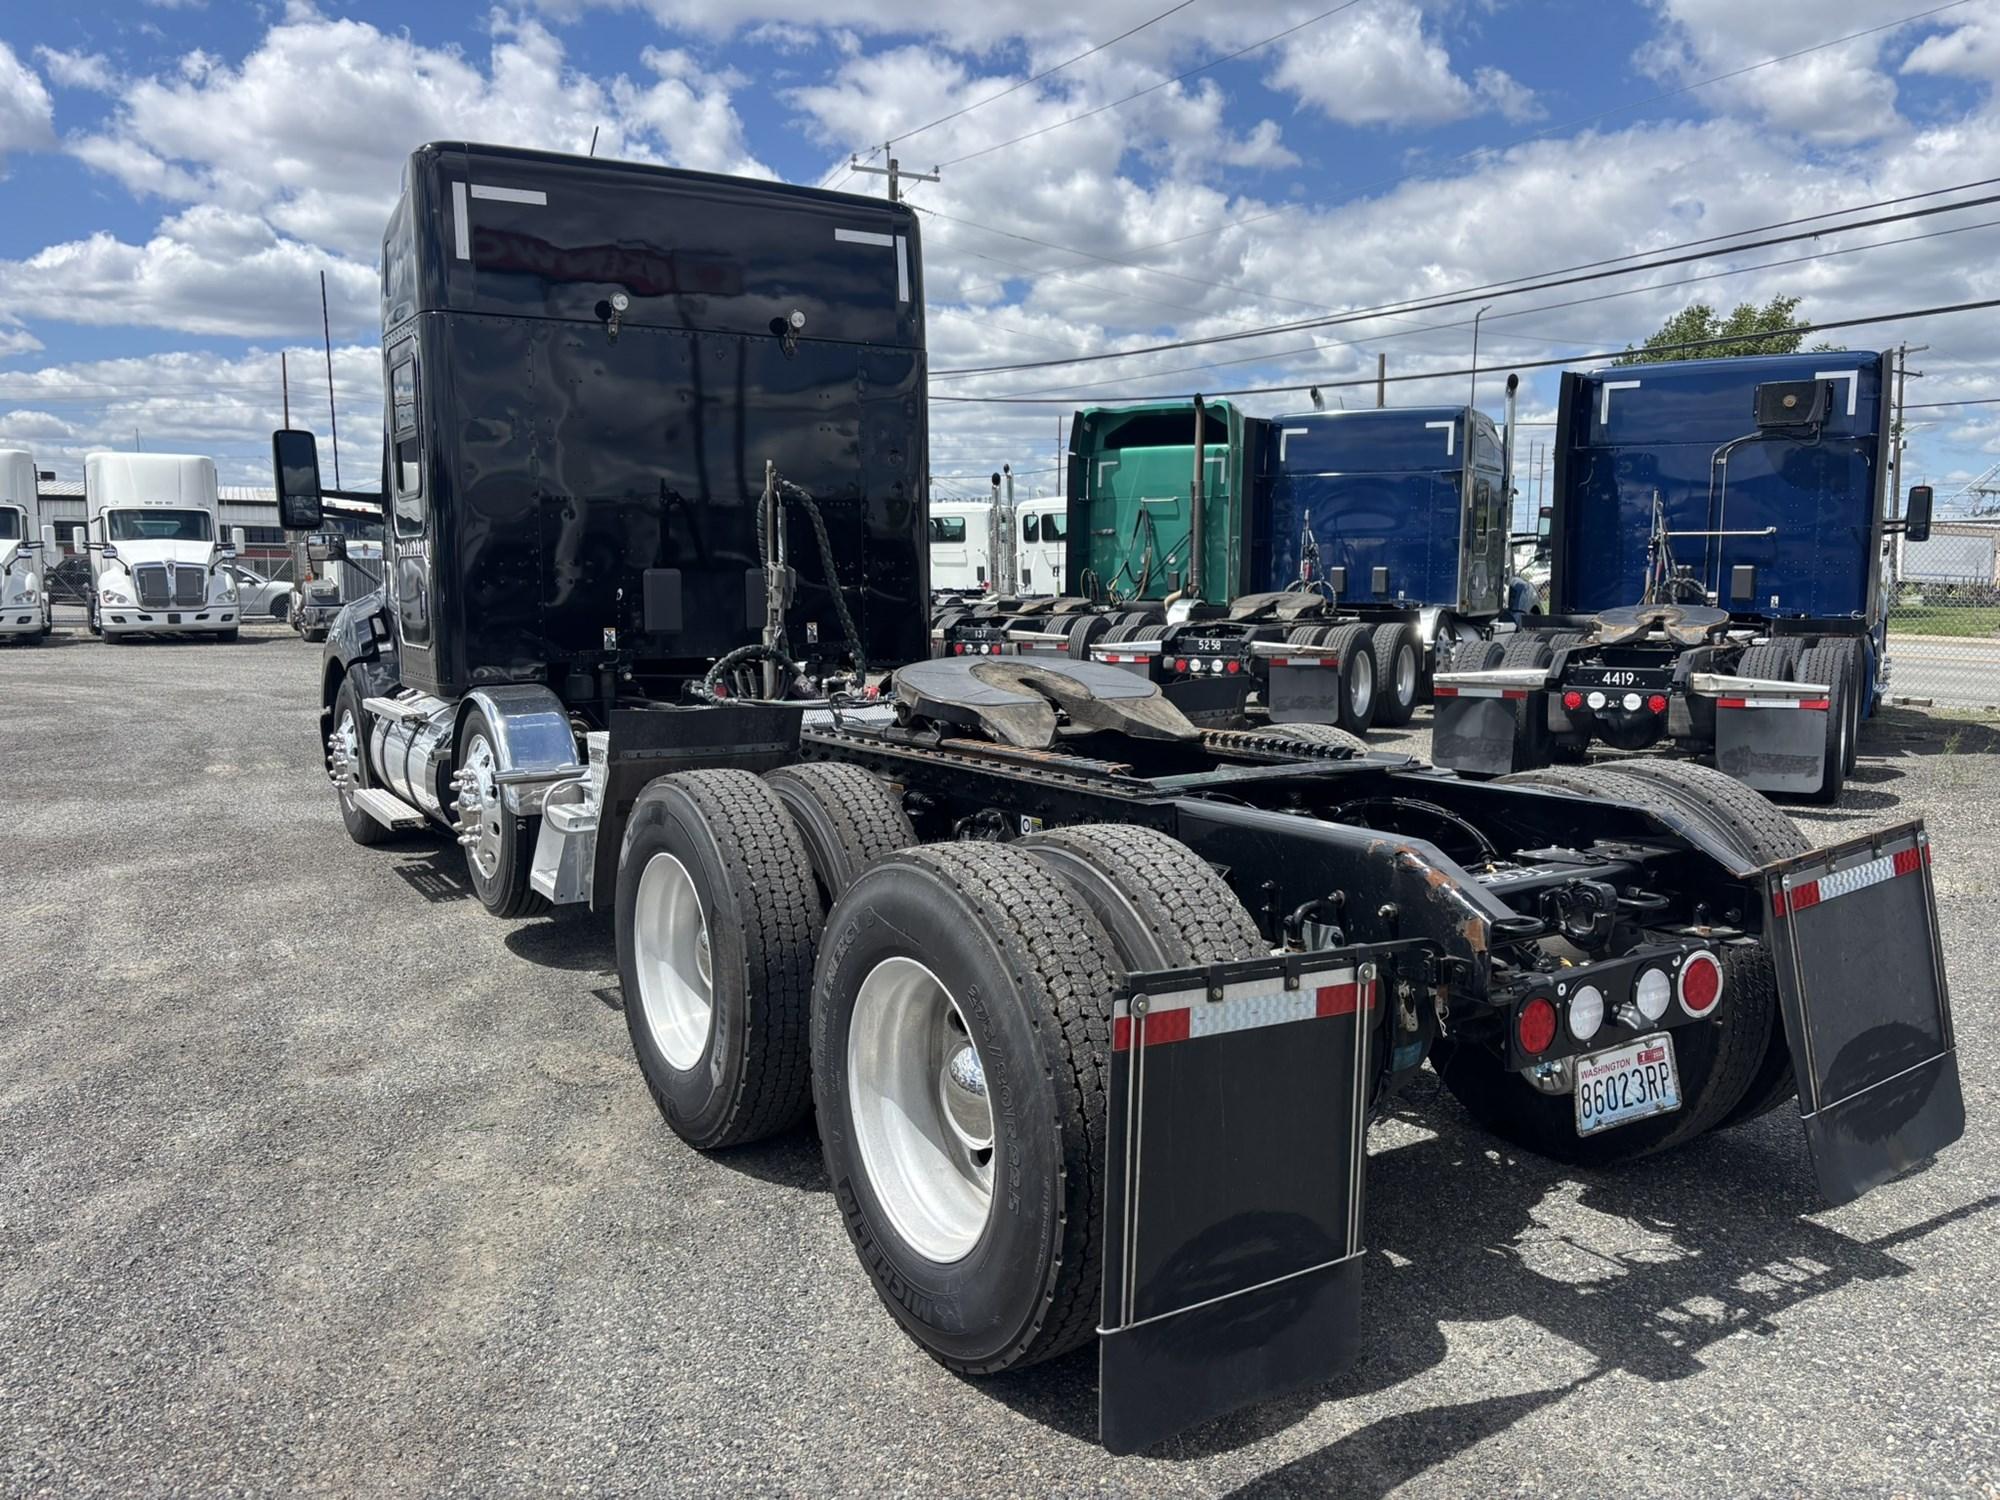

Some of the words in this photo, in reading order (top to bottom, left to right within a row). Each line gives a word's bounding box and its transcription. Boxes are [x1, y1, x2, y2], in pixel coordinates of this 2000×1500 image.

[975, 629, 987, 638] 137
[1602, 672, 1634, 685] 4419
[1581, 1058, 1631, 1079] WASHINGTON
[1581, 1062, 1669, 1119] 86023RP
[840, 1183, 934, 1323] MICHELIN
